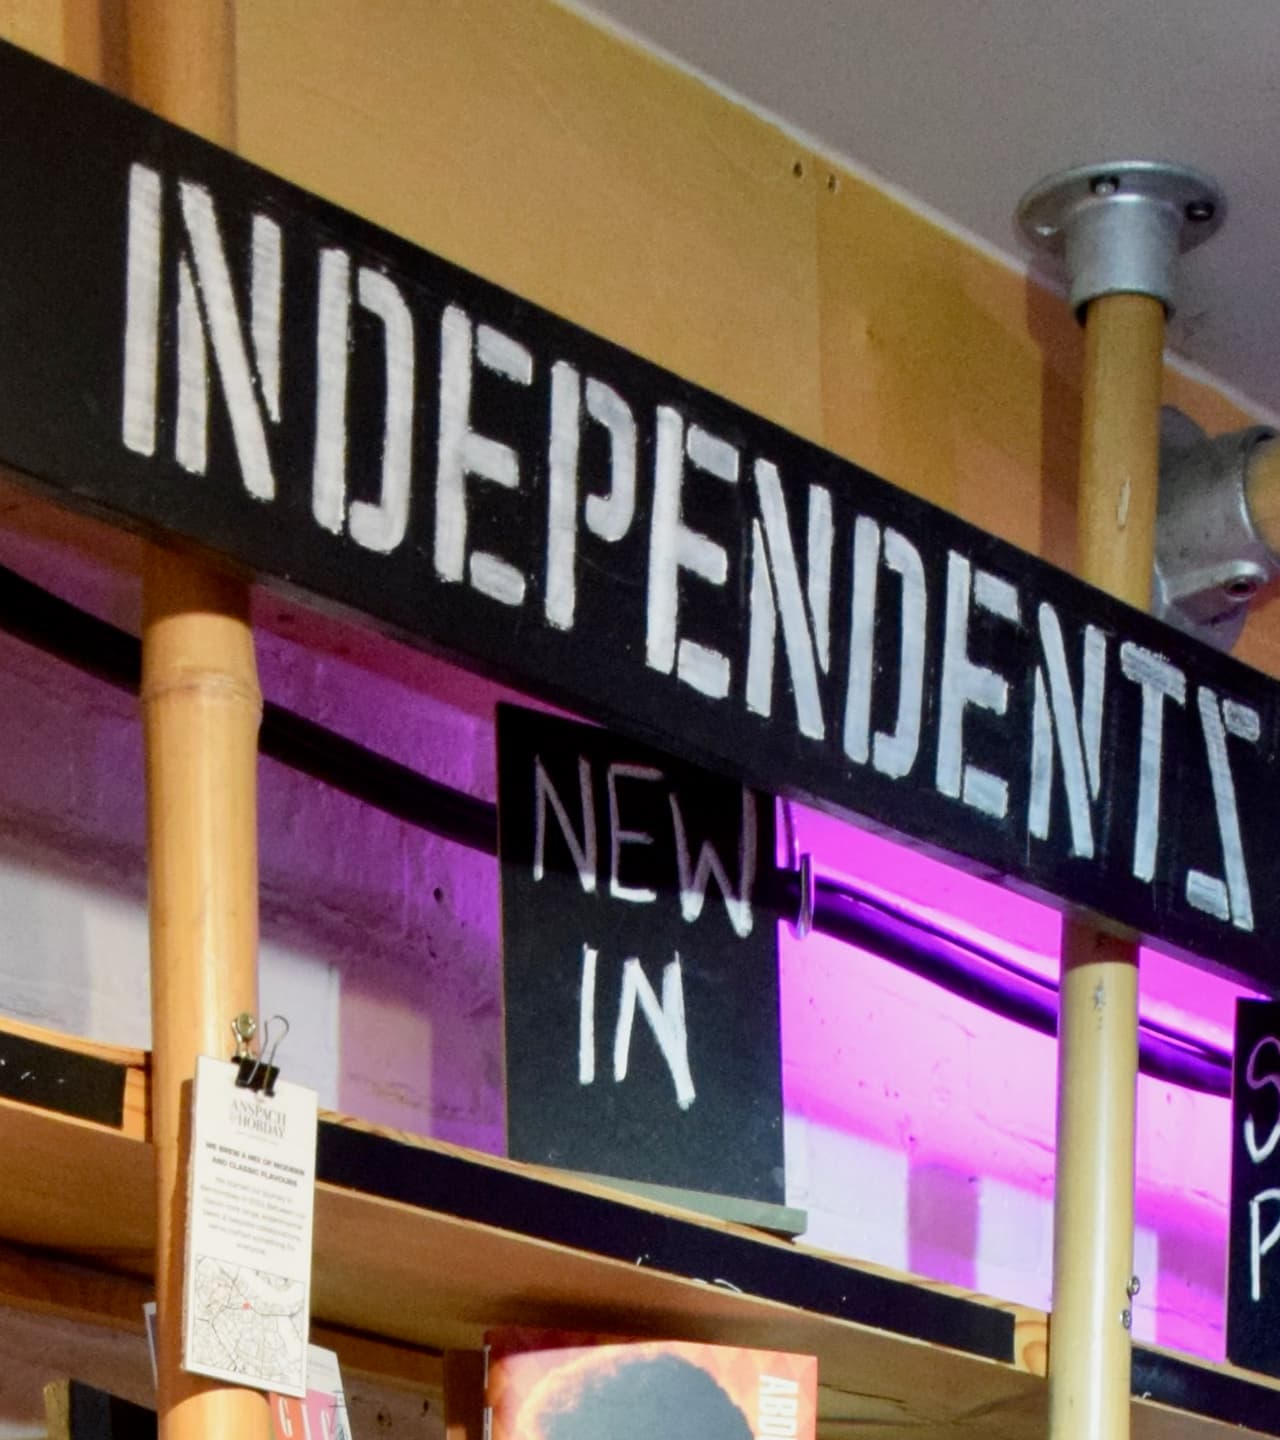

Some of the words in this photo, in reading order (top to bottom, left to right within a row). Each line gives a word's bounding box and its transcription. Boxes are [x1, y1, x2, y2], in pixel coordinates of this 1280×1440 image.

[122, 163, 1261, 933] INDEPENDENTS
[530, 751, 757, 942] NEW
[576, 942, 697, 1111] IN
